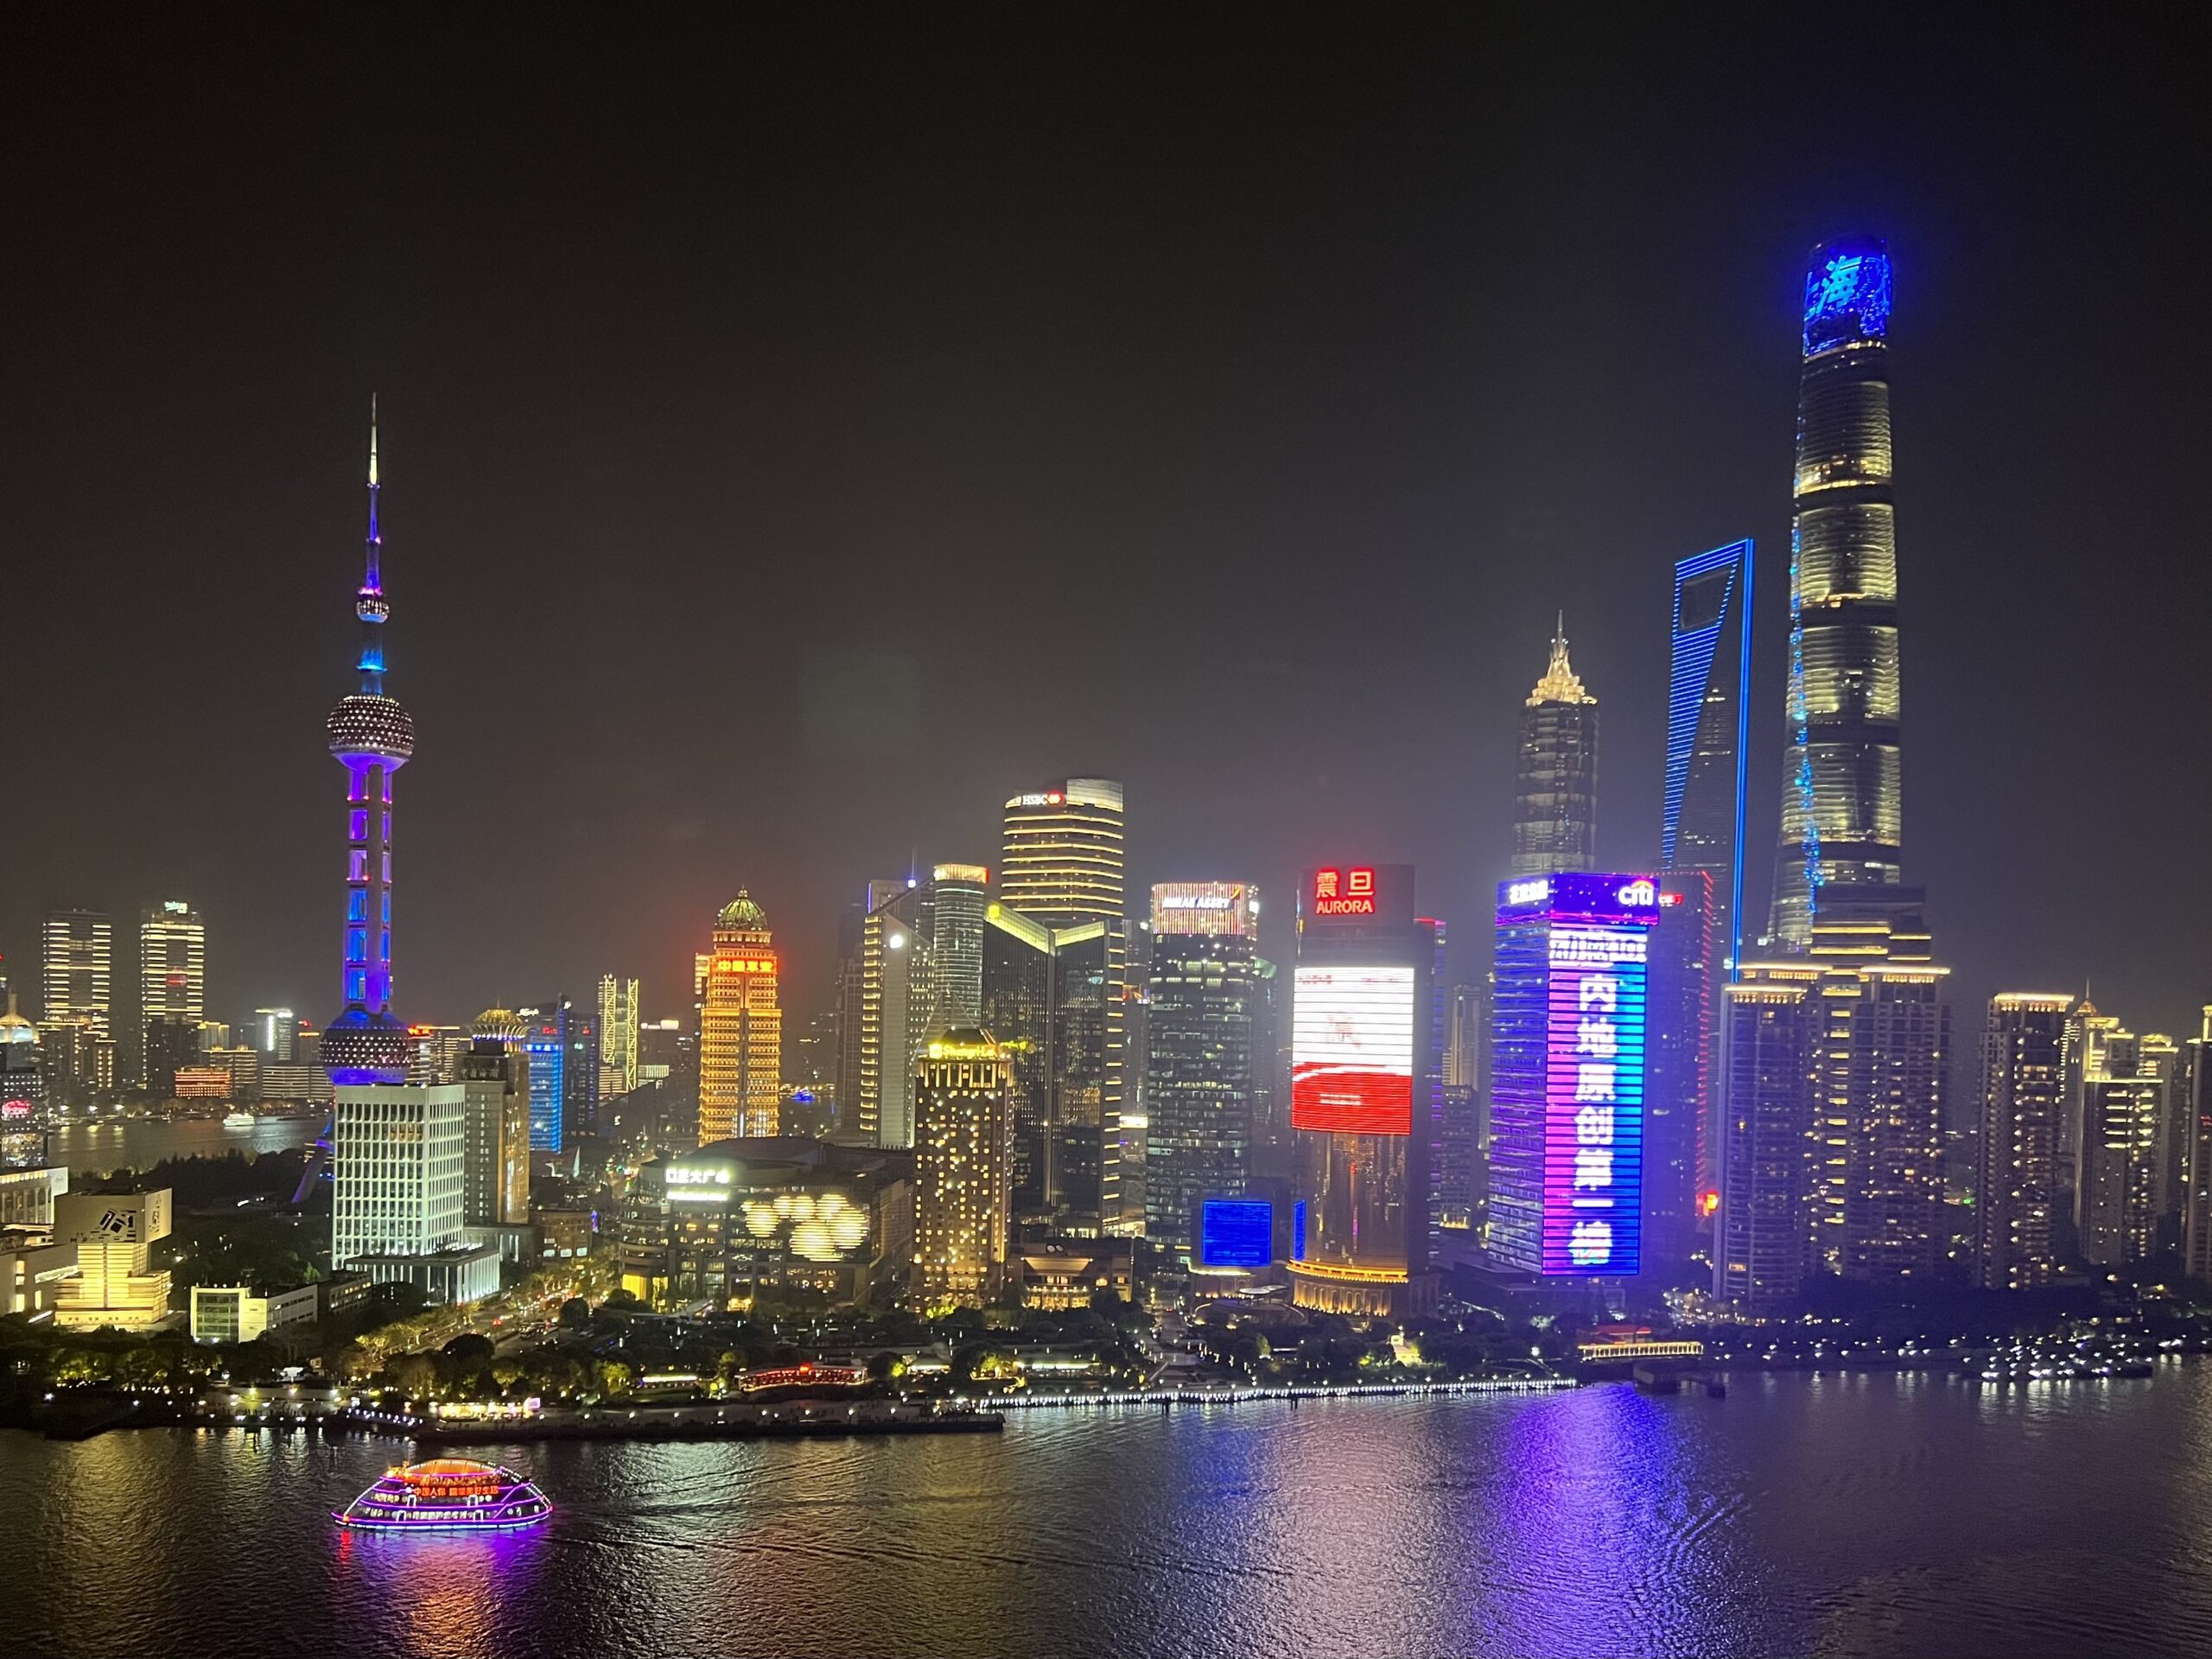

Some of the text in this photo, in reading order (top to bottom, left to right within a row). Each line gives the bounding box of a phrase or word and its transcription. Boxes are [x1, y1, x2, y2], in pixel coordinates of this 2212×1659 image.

[1022, 793, 1048, 805] HSBC
[1315, 870, 1375, 899] 震旦
[1618, 885, 1654, 906] citi
[1315, 899, 1374, 914] AURORA
